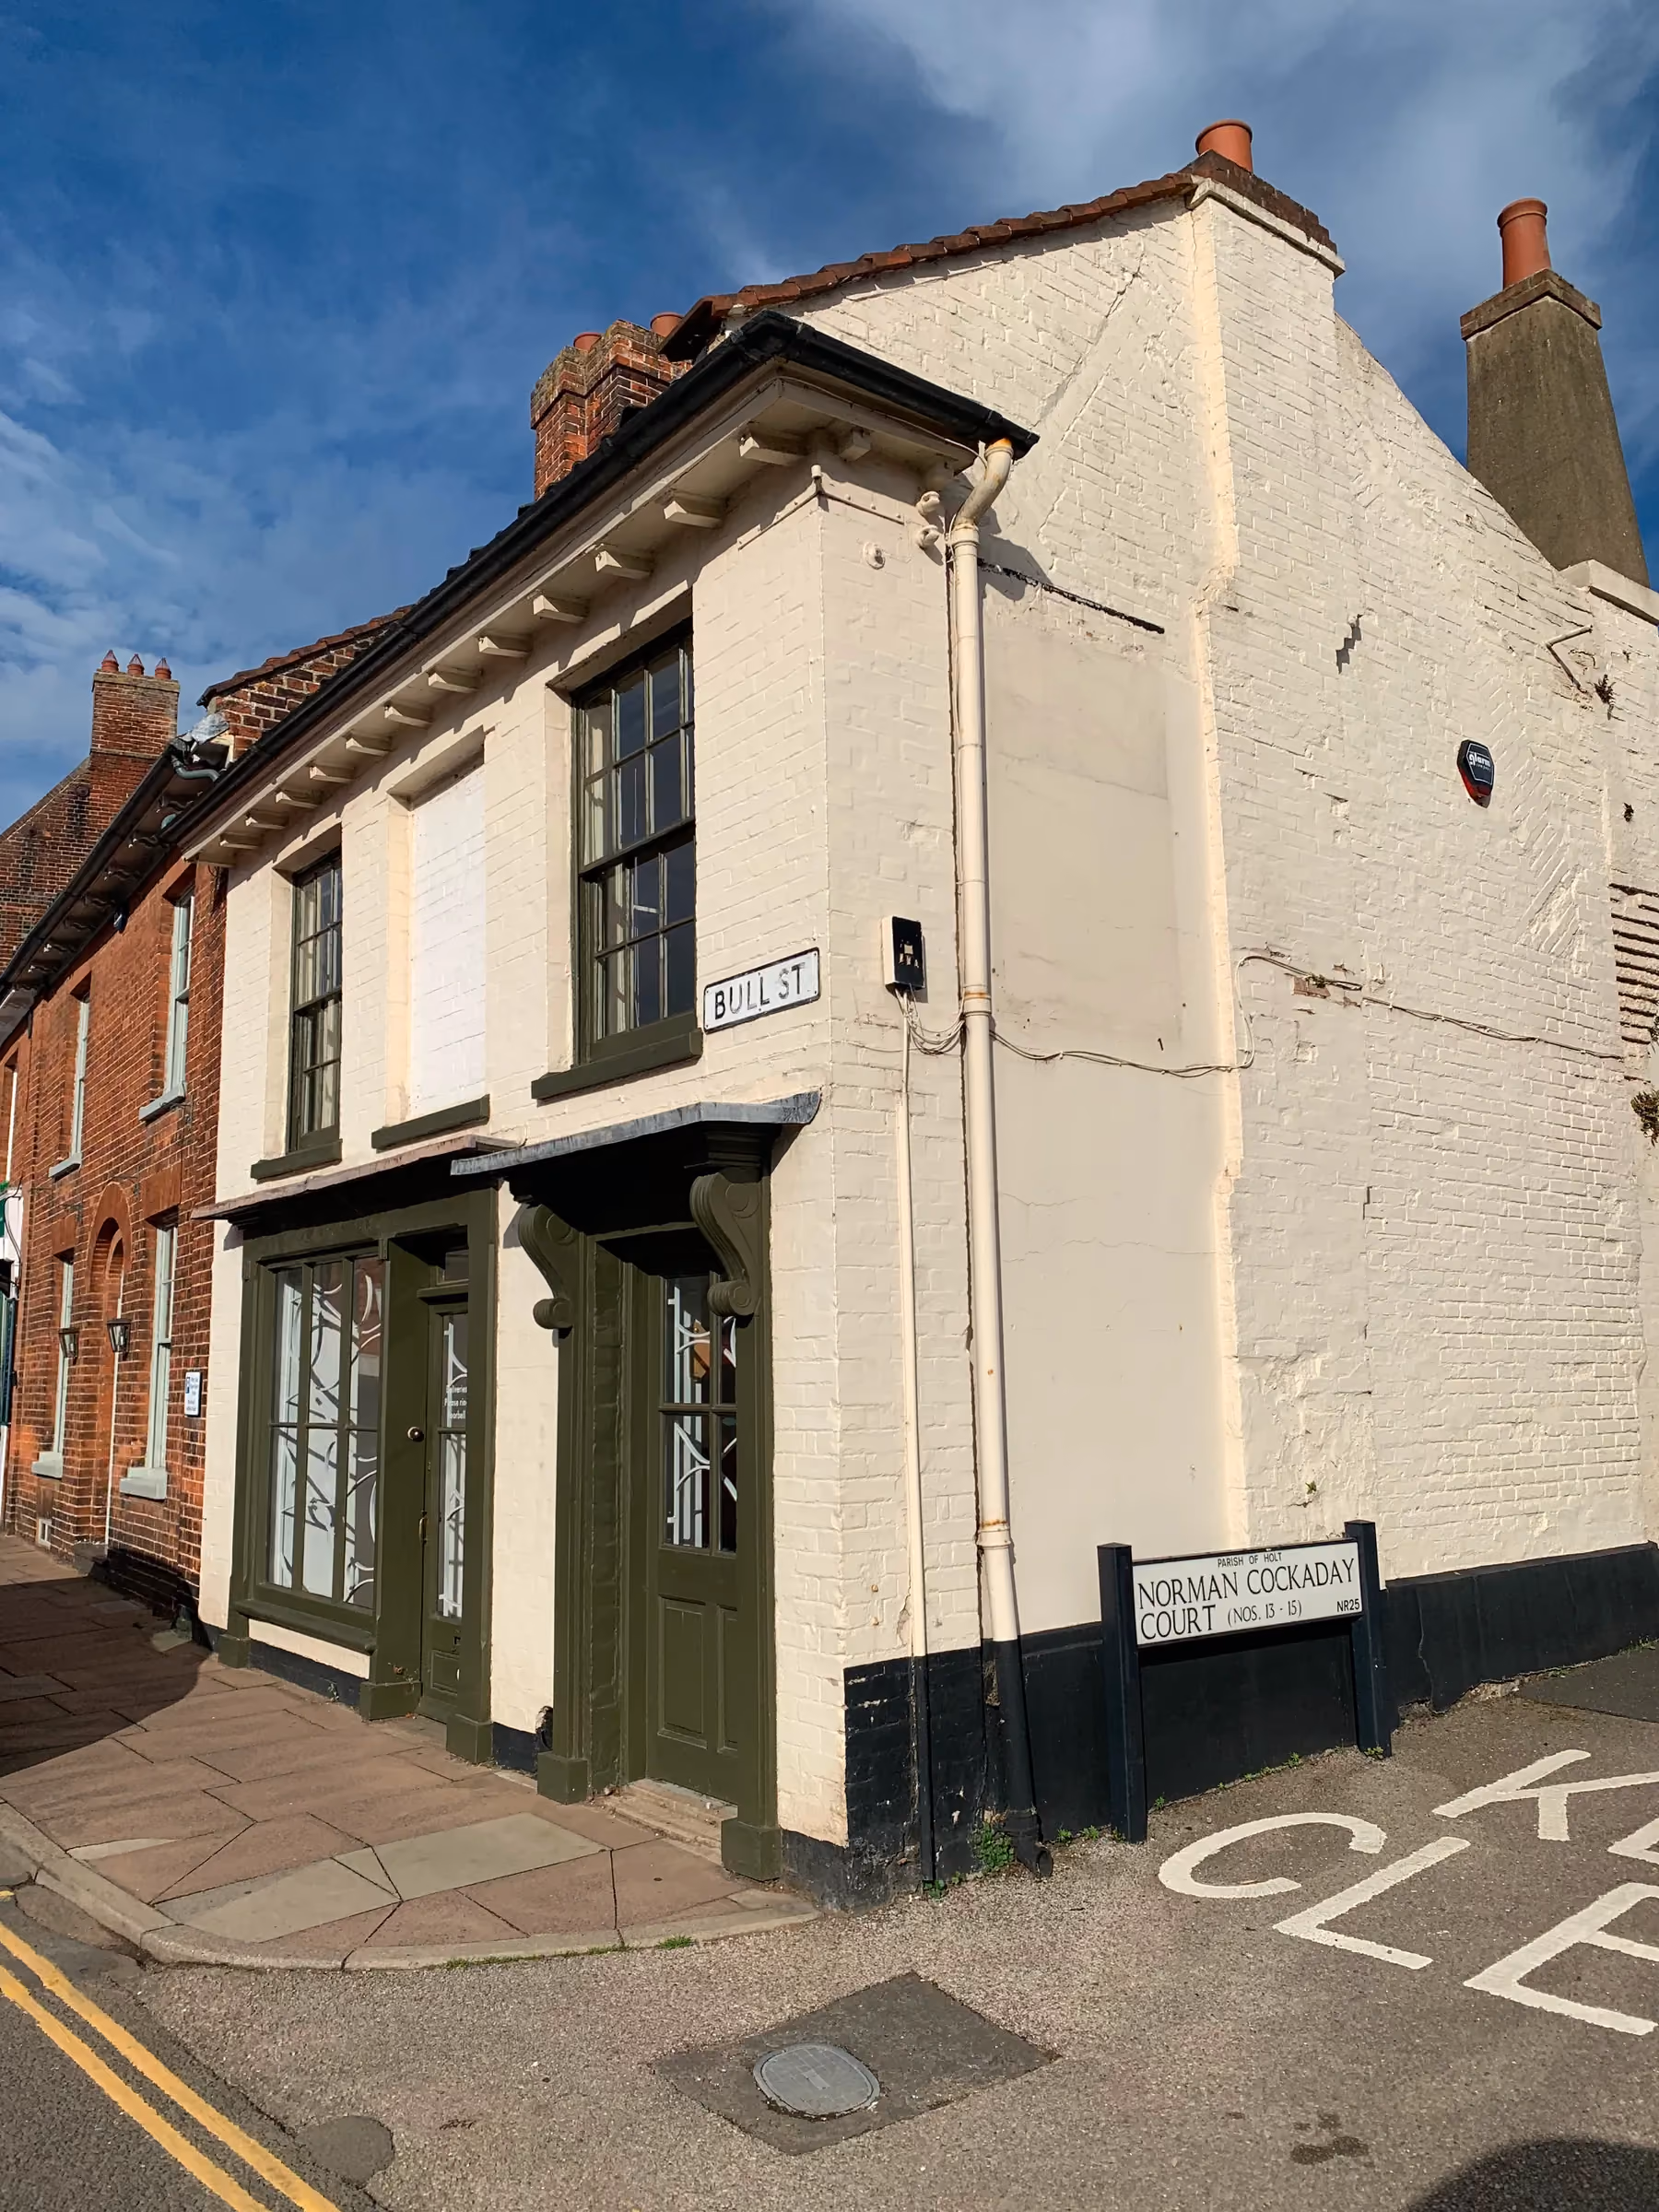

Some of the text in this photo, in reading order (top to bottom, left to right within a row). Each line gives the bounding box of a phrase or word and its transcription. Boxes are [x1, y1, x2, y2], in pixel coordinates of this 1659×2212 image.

[714, 962, 806, 1020] BULL ST
[1218, 1552, 1282, 1568] PARISH OF HOLT
[1137, 1558, 1355, 1609] NORMAN COCKADAY
[1140, 1604, 1217, 1640] COURT
[1228, 1606, 1262, 1629] (NOS.
[1265, 1603, 1276, 1619] 13
[1288, 1599, 1302, 1618] 15)
[1336, 1598, 1360, 1613] NR25
